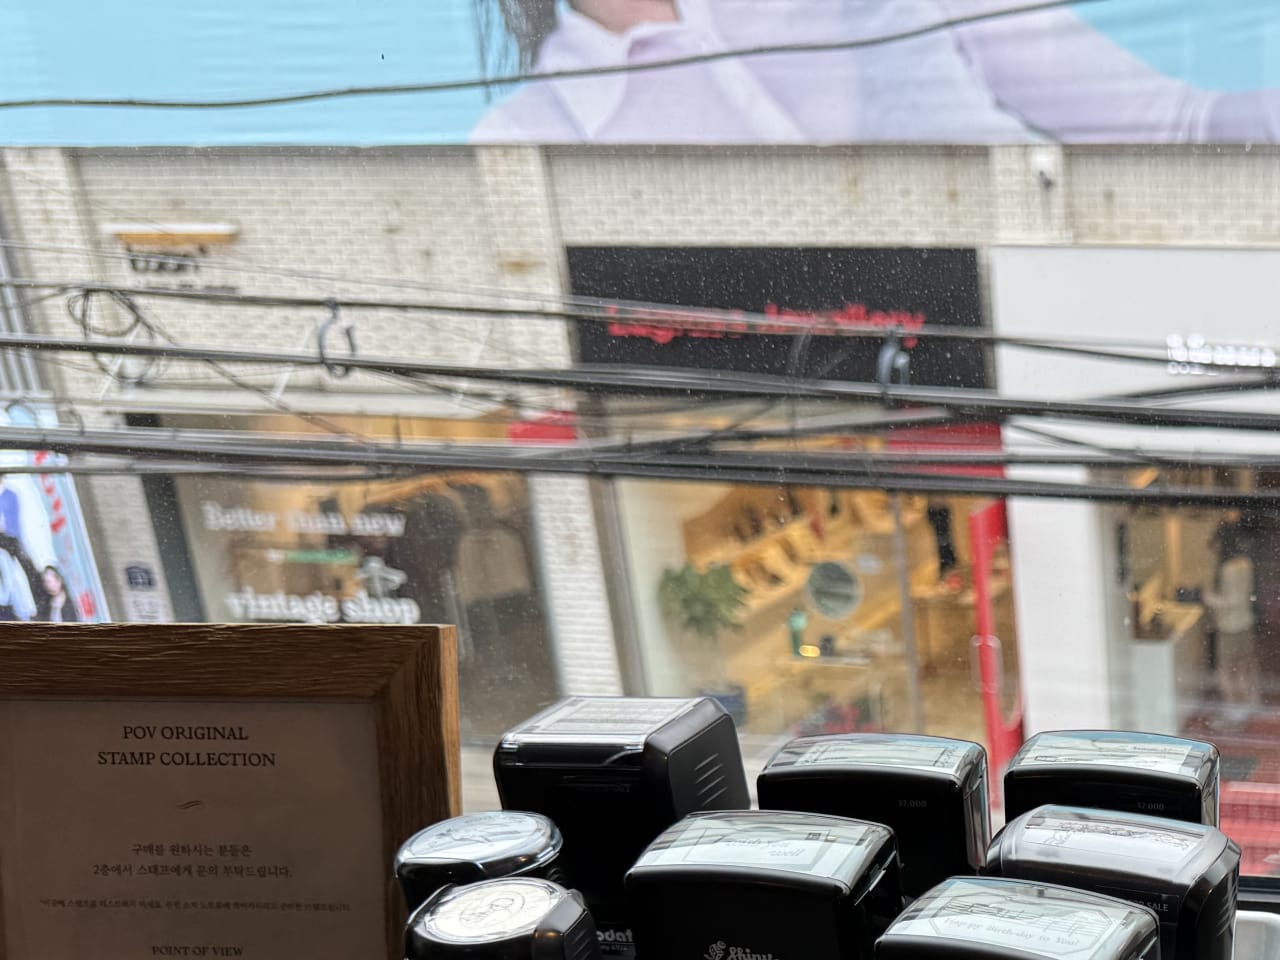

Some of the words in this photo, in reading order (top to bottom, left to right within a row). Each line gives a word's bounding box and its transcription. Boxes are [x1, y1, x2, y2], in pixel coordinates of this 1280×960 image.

[202, 502, 276, 531] Better
[351, 512, 406, 536] new
[223, 587, 340, 624] vintage
[341, 590, 421, 624] shop
[123, 726, 157, 740] POV
[160, 726, 249, 741] ORIGINAL
[97, 751, 155, 766] STAMP
[159, 752, 276, 767] COLLECTION
[169, 844, 214, 857] 원하시는
[595, 928, 633, 943] odat
[151, 946, 190, 957] POINT
[193, 946, 209, 957] OF
[212, 946, 244, 957] VIEW
